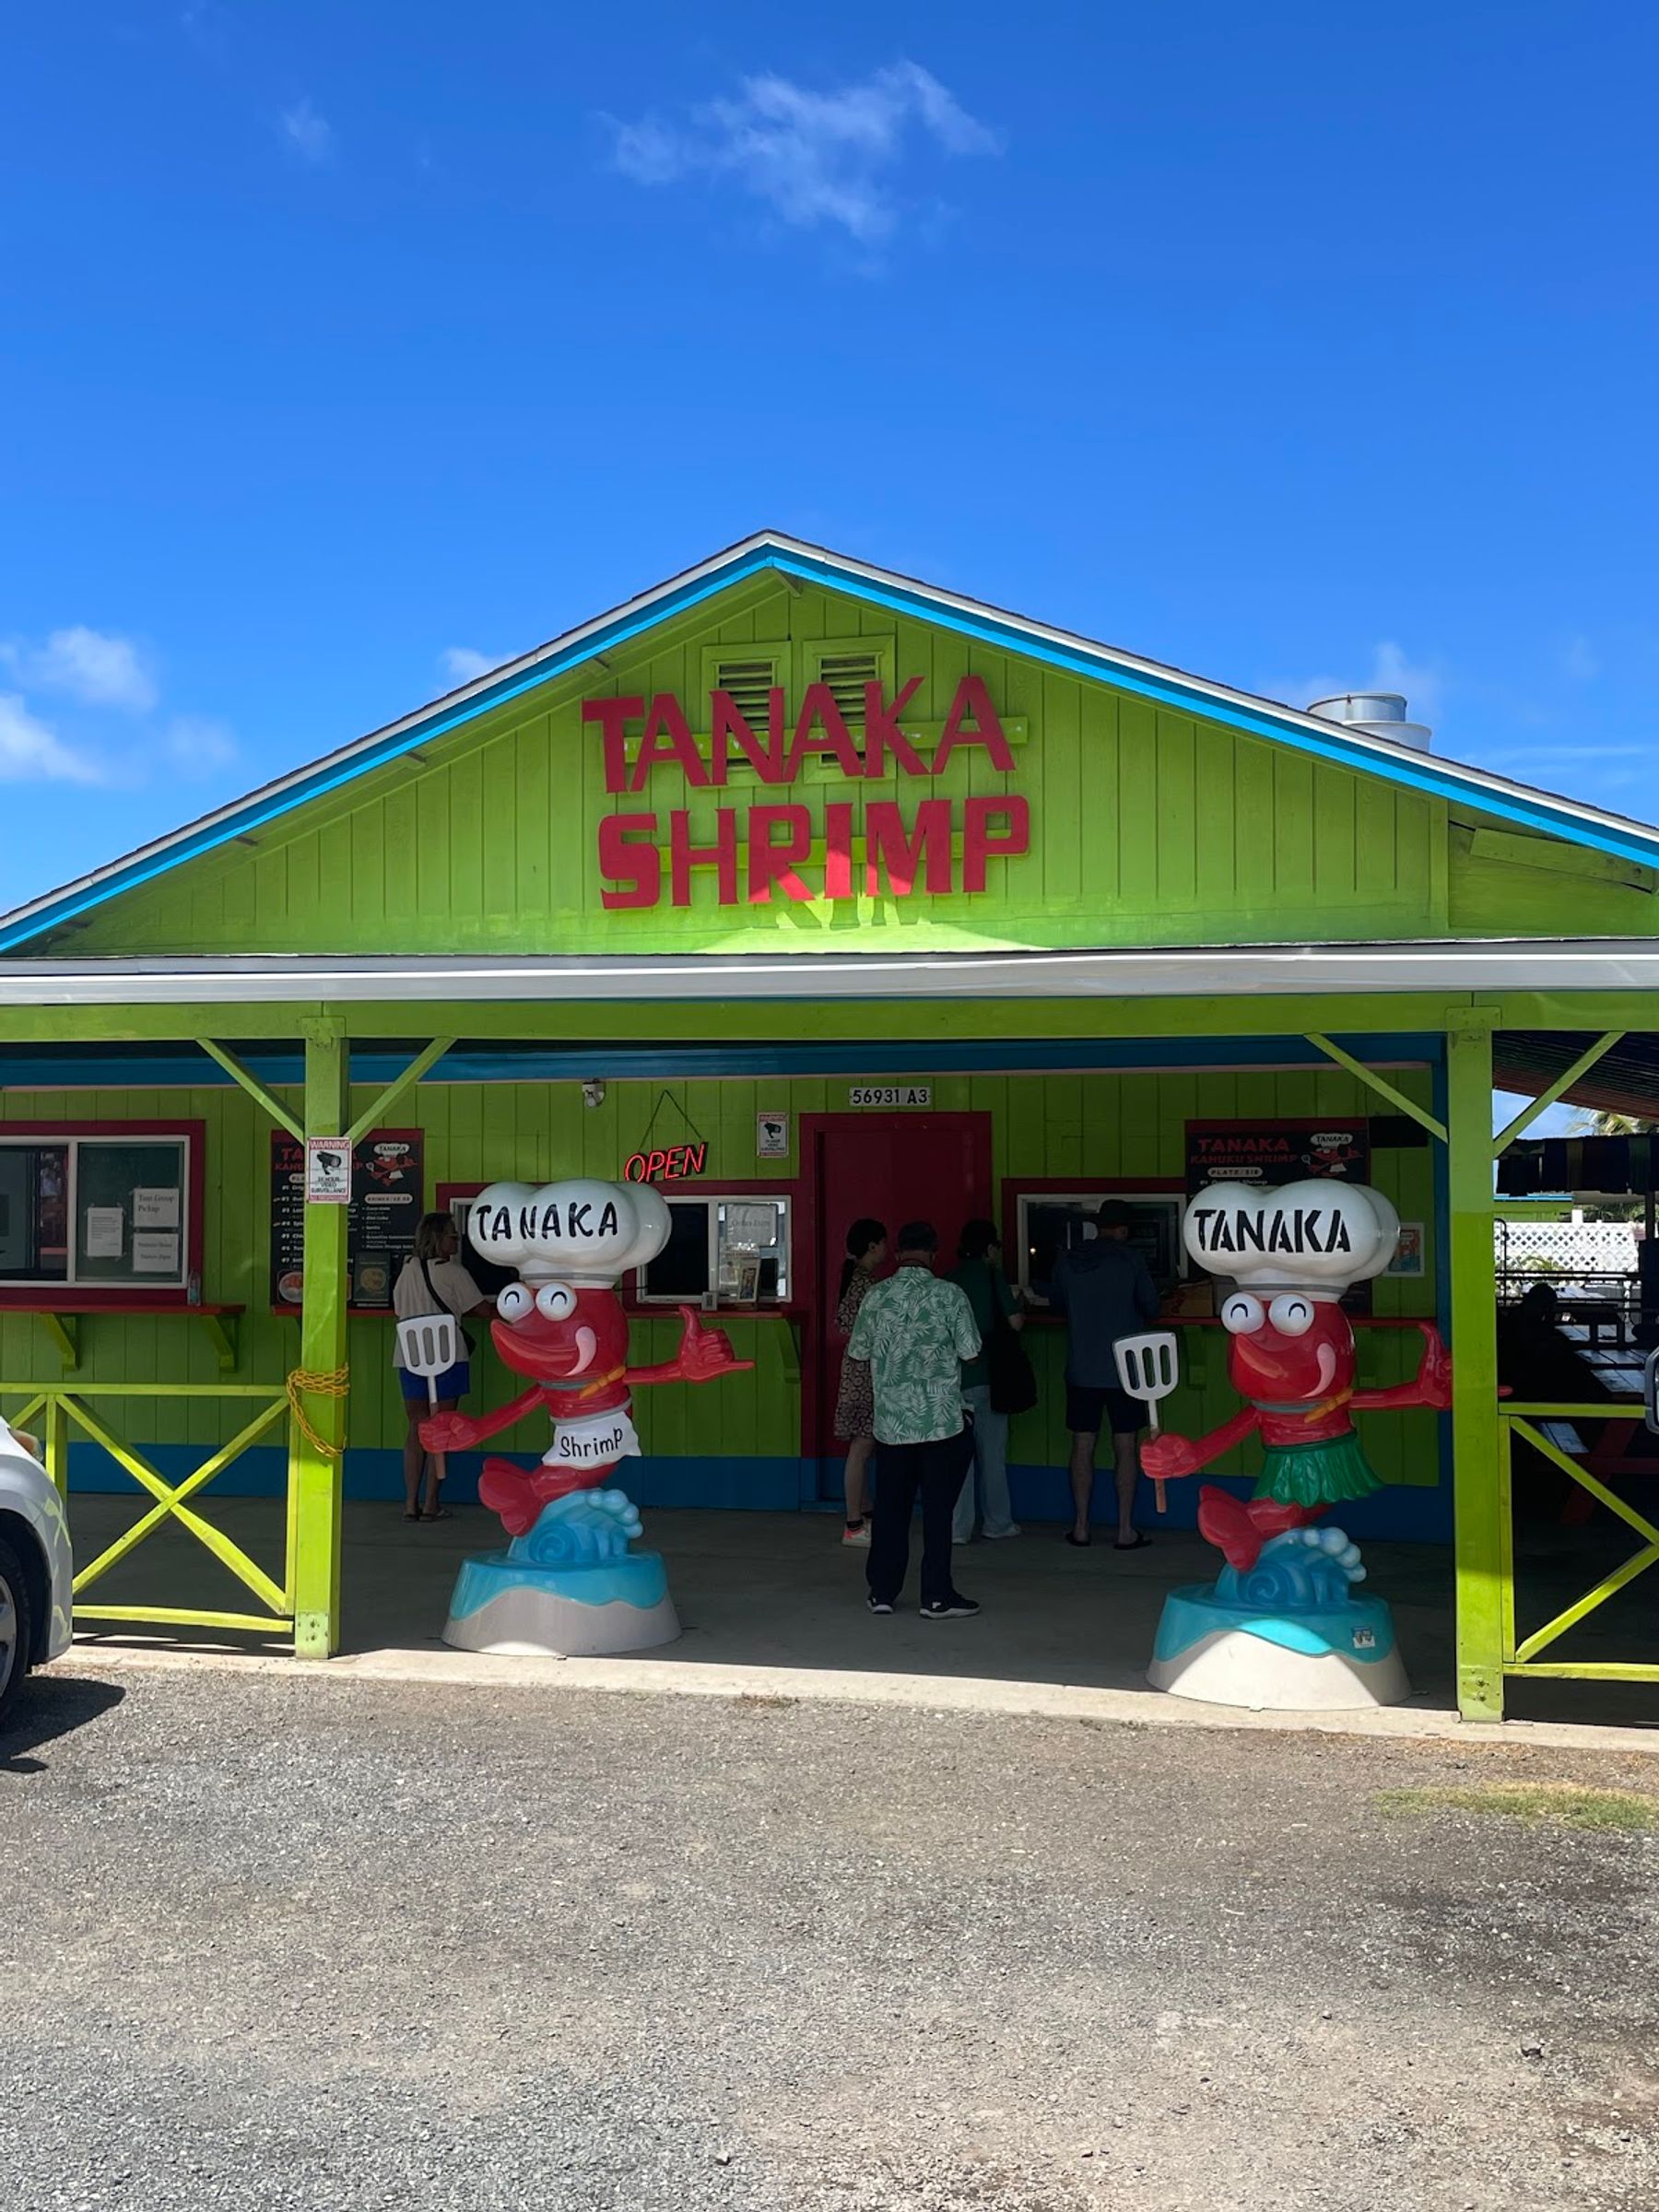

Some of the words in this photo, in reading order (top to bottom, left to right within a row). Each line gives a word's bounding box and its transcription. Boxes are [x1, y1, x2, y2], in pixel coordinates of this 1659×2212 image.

[582, 675, 1017, 794] TANAKA
[598, 795, 1030, 910] SHRIMP
[853, 1089, 900, 1104] 56931
[907, 1089, 927, 1104] A3
[310, 1140, 349, 1149] WARNING
[624, 1143, 706, 1182] OPEN
[1198, 1139, 1290, 1152] TANAKA
[477, 1201, 618, 1241] TANAKA
[1194, 1209, 1351, 1253] TANAKA
[559, 1428, 623, 1457] Shrimp
